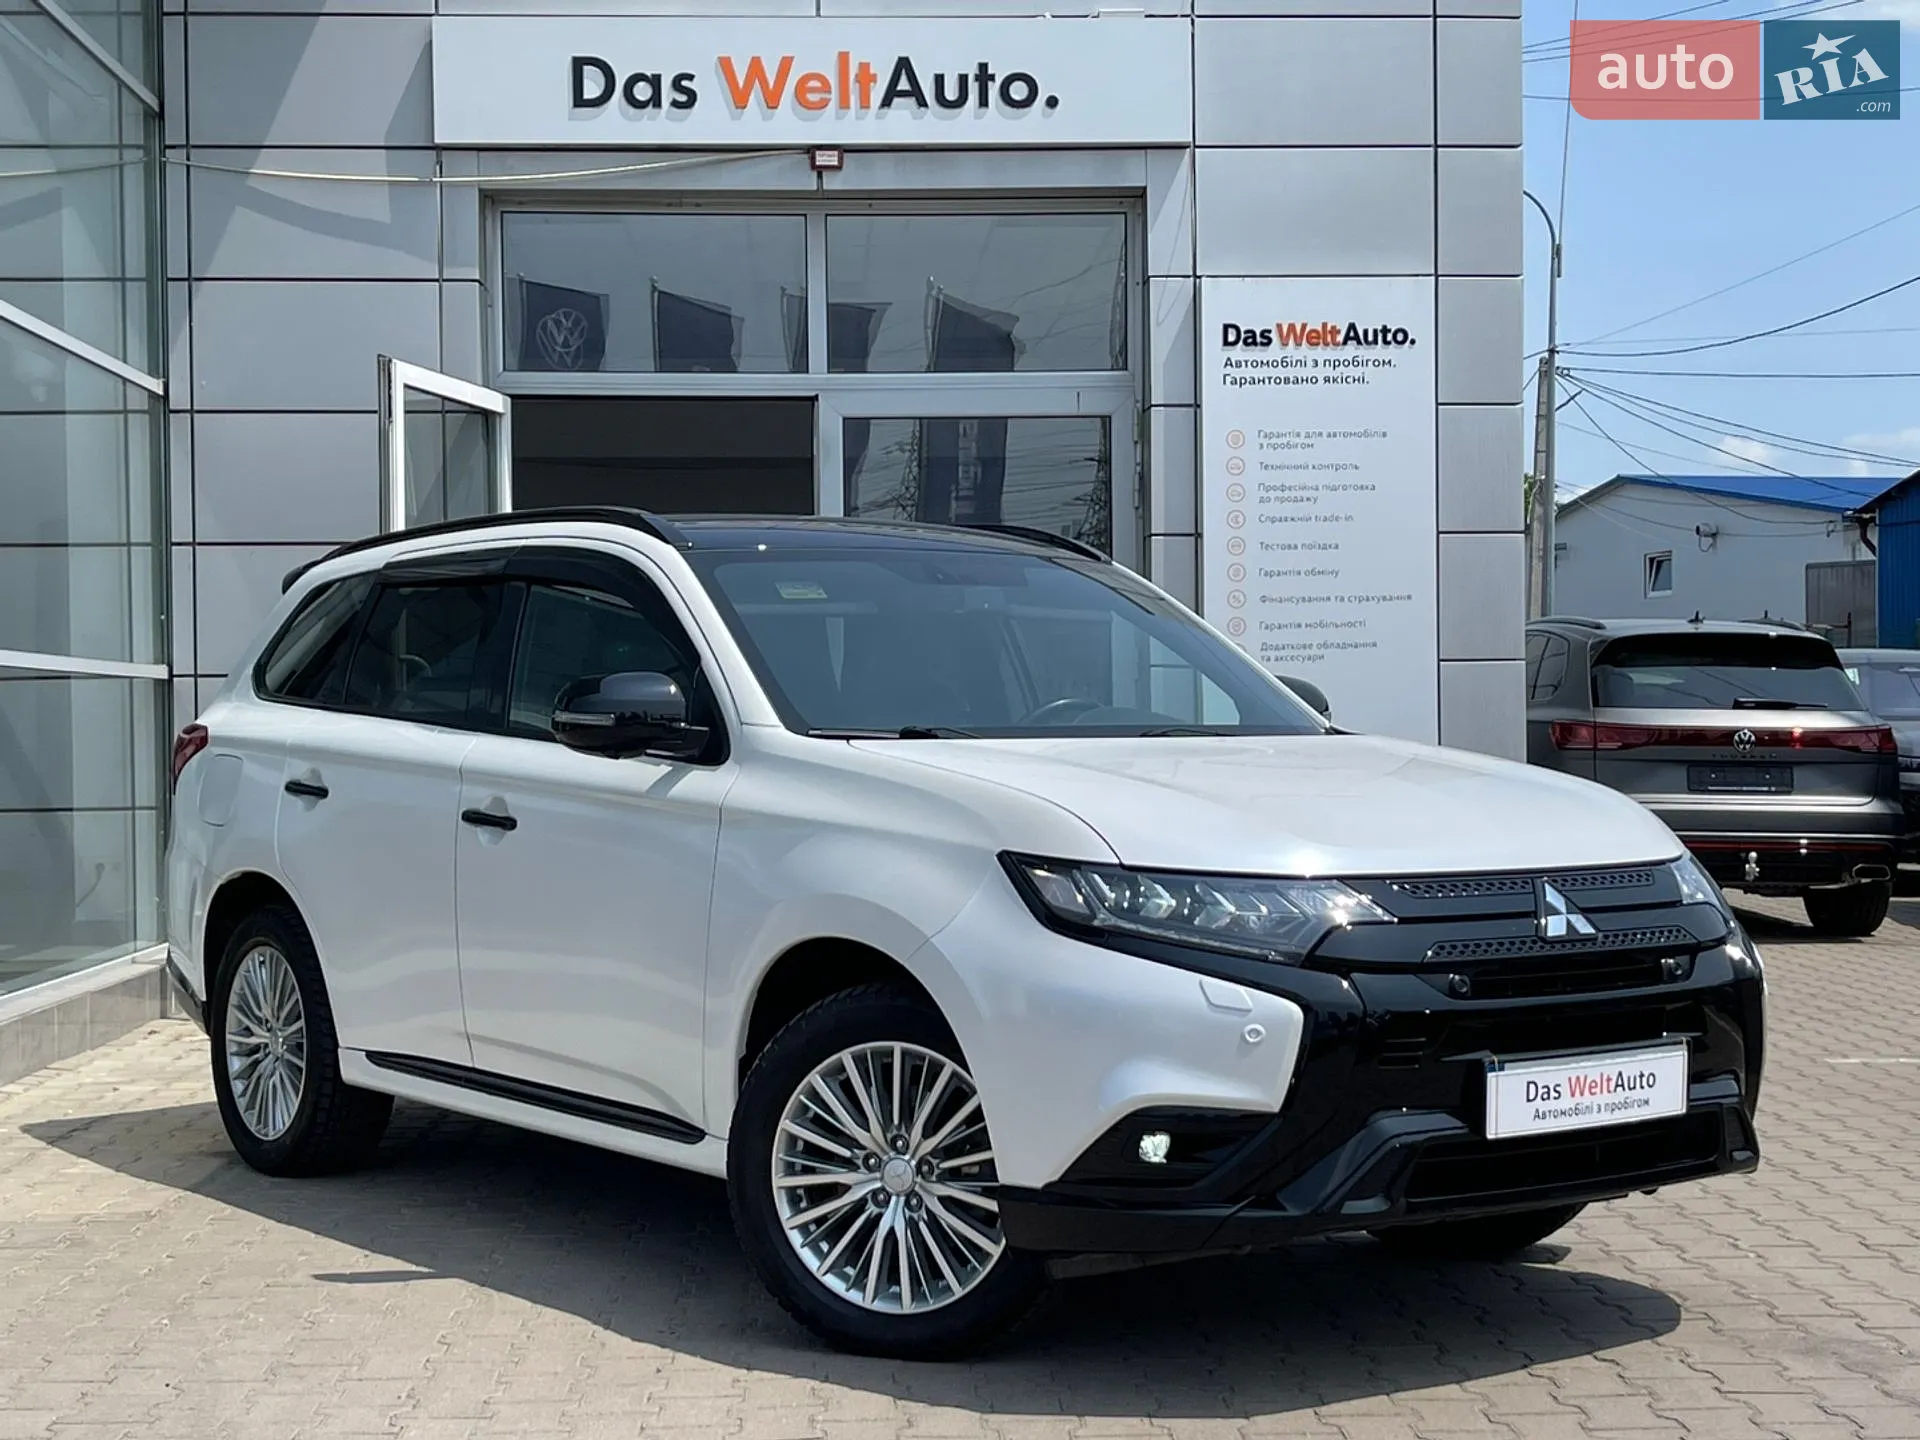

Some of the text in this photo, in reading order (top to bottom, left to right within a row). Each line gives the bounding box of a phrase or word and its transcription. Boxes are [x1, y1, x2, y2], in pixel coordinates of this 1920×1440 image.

[571, 51, 1060, 111] Das WeltAuto.
[1222, 322, 1416, 347] Das WeltAuto.
[1223, 356, 1397, 370] Автомобілі з пробігом.
[1223, 373, 1369, 387] Гарантовано якісні.
[1257, 429, 1388, 439] Гарантія для автомобілів
[1267, 441, 1314, 451] пробігом
[1259, 462, 1359, 472] Технічний контроль
[1258, 483, 1376, 493] Професійна підготовка
[1259, 495, 1318, 505] до продажу
[1259, 514, 1354, 524] Справжній trade-in
[1259, 542, 1339, 551] Тестова поїздка
[1259, 568, 1340, 578] Гарантія обміну
[1259, 595, 1331, 605] Фінансування
[1348, 593, 1412, 603] страхування
[1259, 620, 1366, 632] Гарантія мобільності
[1260, 641, 1377, 652] Додаткове обладнання
[1261, 653, 1325, 663] та аксесуари
[1526, 1071, 1656, 1103] Das WeltAuto
[1533, 1097, 1650, 1121] Автомобілі з пробігом
